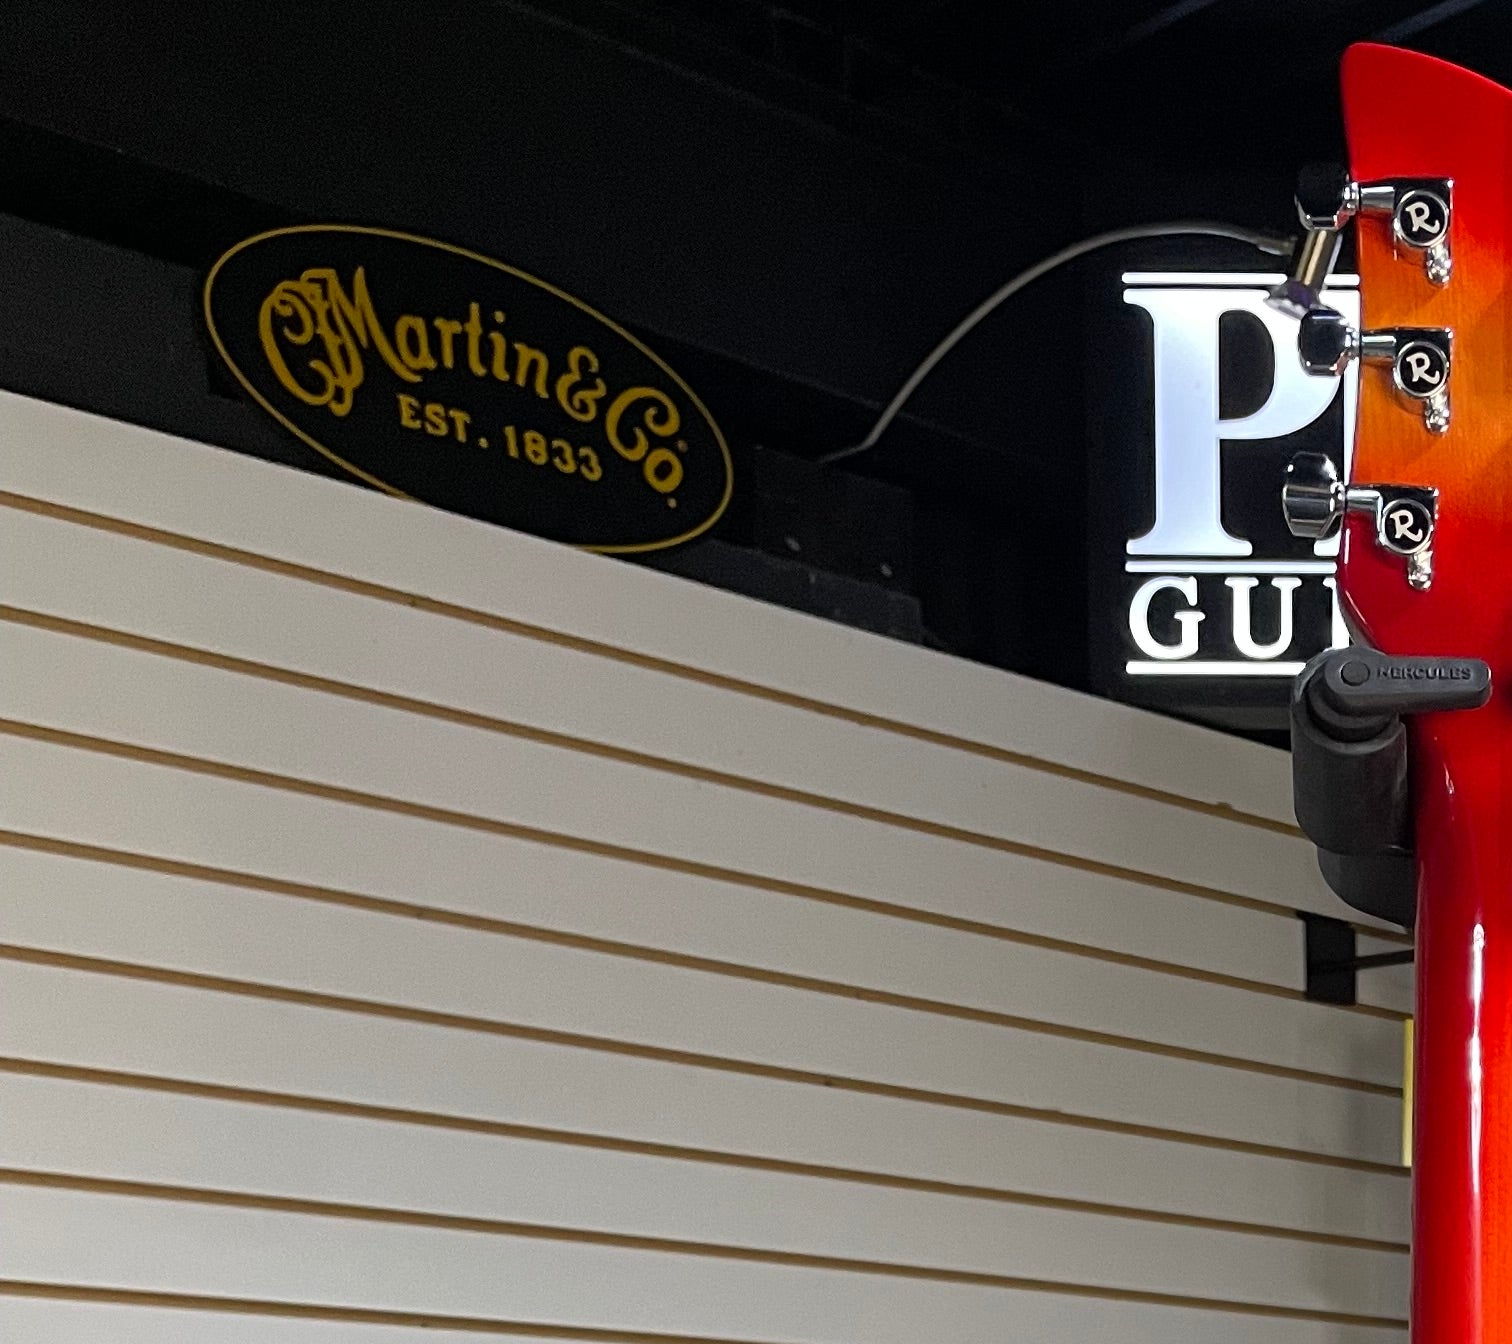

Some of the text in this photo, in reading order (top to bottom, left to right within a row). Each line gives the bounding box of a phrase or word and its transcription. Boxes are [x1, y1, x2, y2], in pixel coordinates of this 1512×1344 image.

[397, 392, 604, 483] EST. 1833
[1376, 666, 1472, 681] HERCULES
